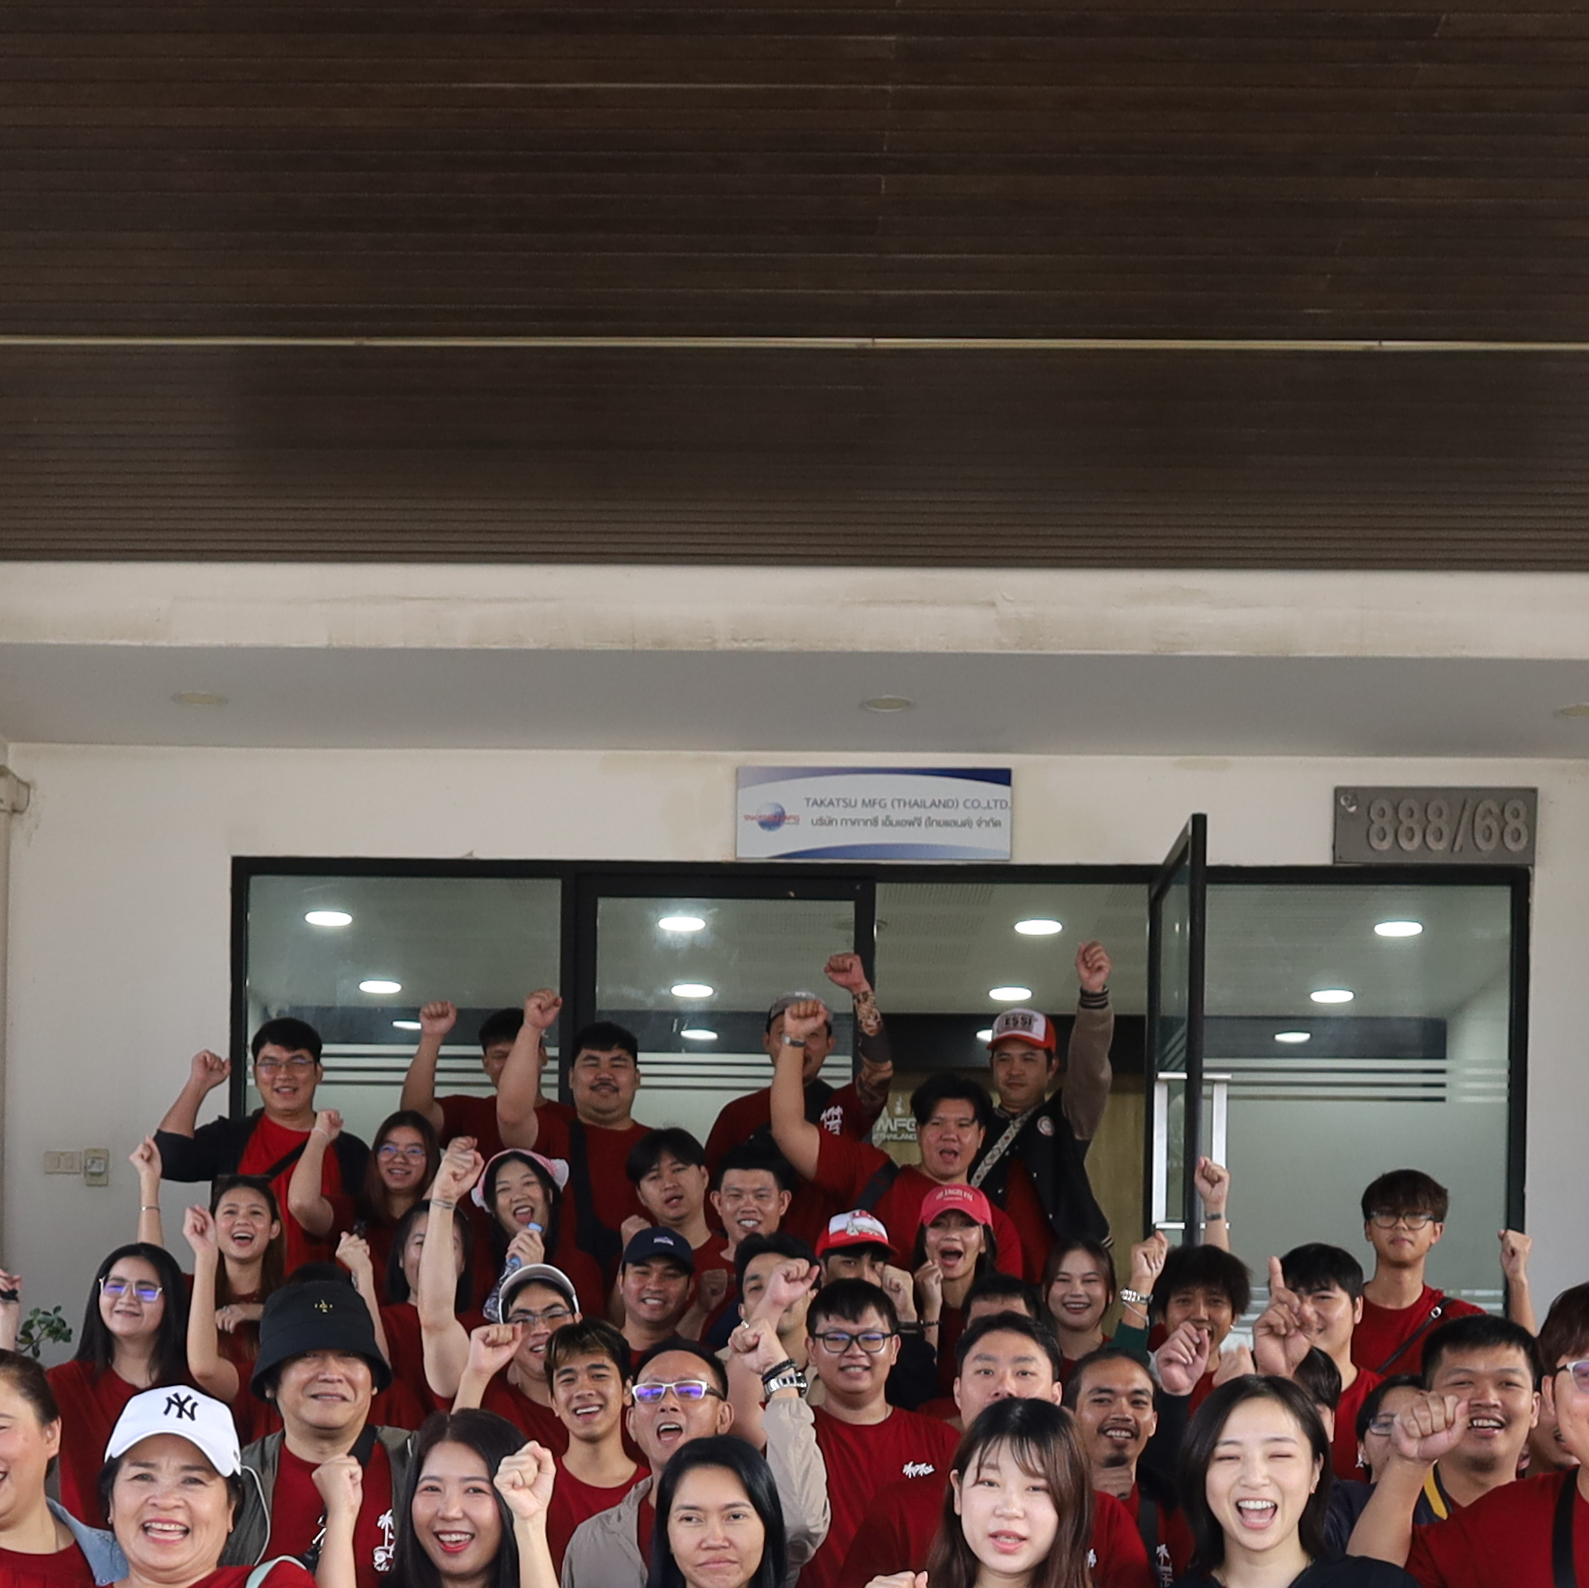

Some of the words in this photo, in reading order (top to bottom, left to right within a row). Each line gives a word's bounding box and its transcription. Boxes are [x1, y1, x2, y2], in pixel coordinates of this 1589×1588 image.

[805, 797, 857, 809] TAKATSU
[862, 797, 887, 809] MFG
[891, 796, 960, 811] (THAILAND)
[1367, 799, 1529, 853] 888/68
